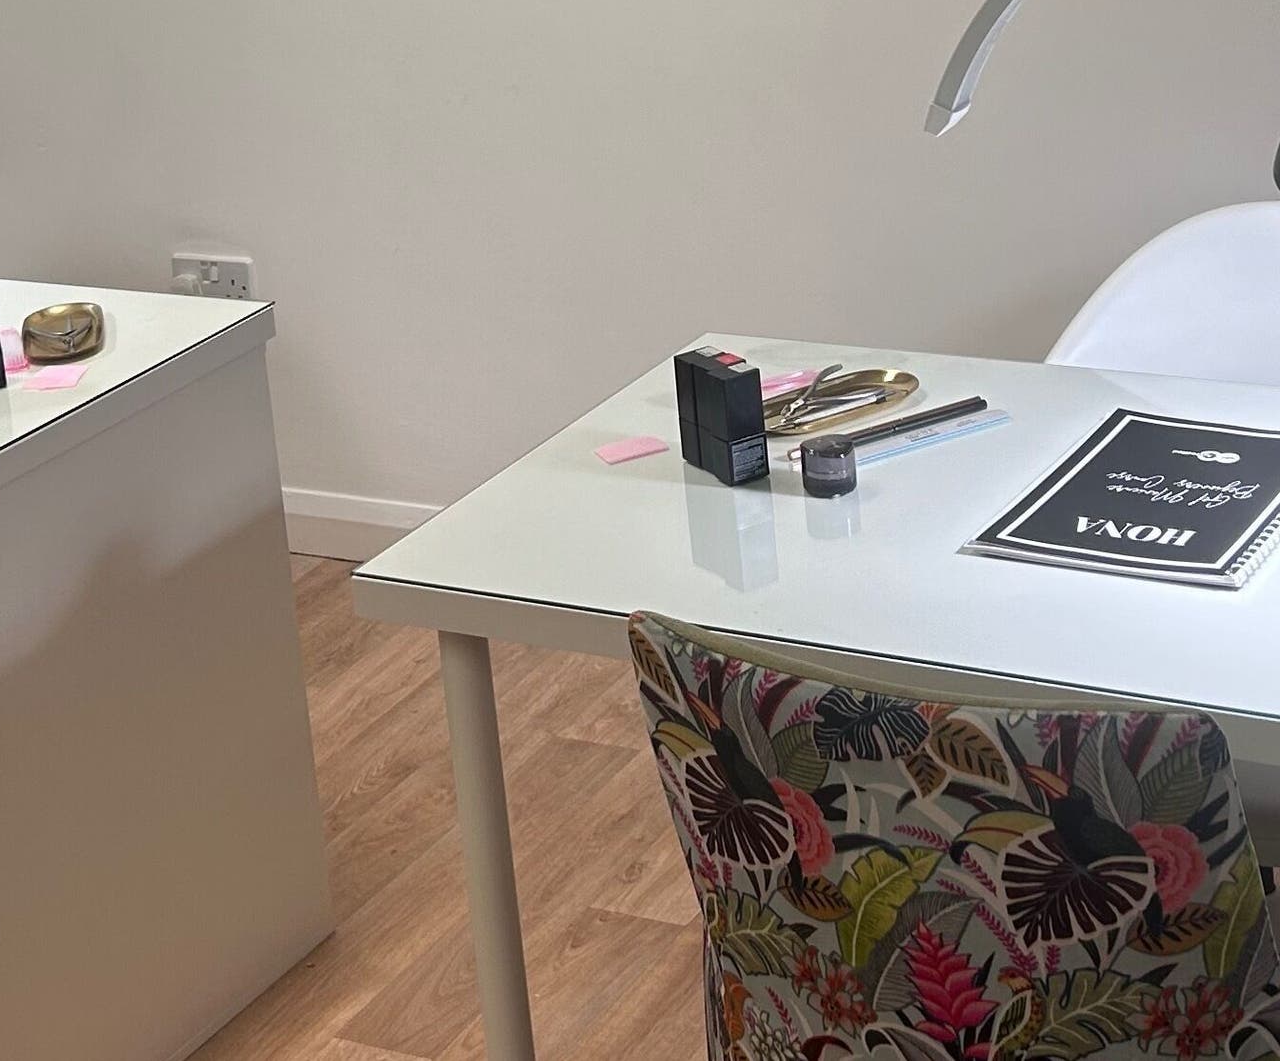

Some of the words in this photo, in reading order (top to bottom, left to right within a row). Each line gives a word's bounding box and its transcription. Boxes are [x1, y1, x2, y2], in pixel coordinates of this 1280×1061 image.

[1105, 471, 1166, 489] Course
[1106, 484, 1190, 504] Manicure
[1187, 492, 1231, 509] Gel
[1076, 515, 1197, 547] HONA
